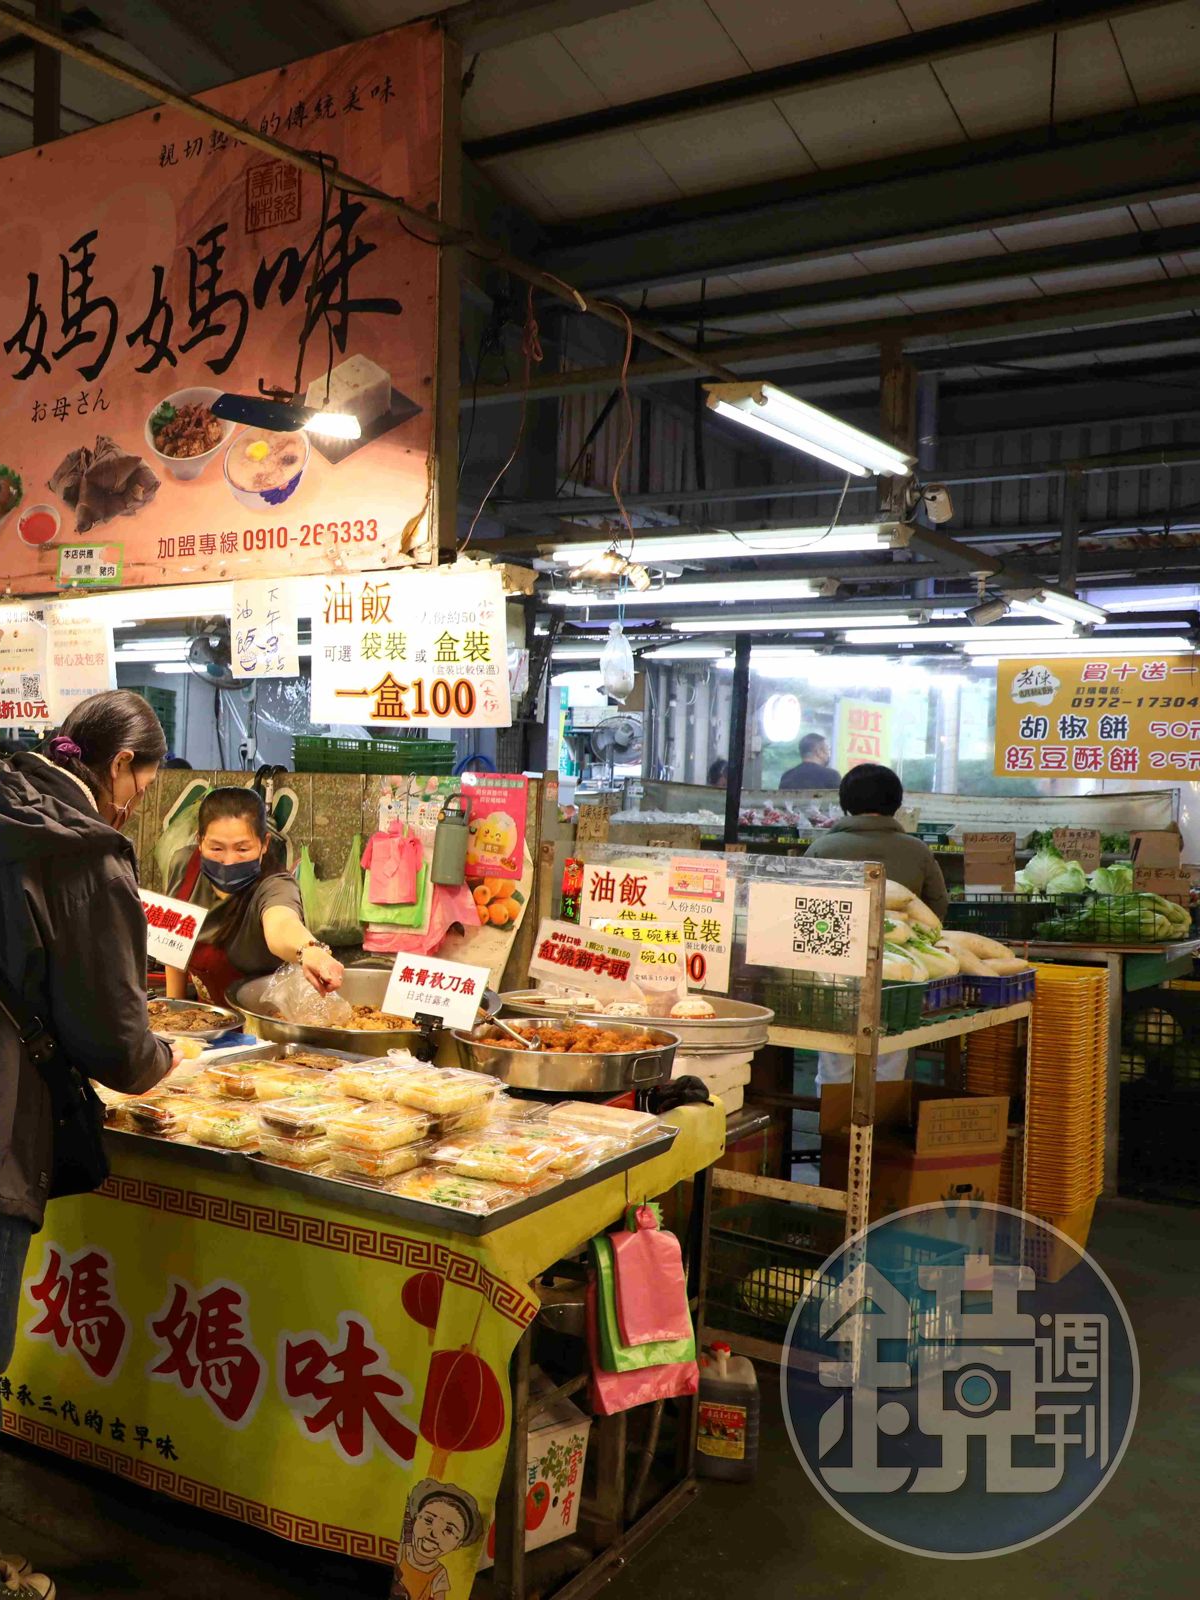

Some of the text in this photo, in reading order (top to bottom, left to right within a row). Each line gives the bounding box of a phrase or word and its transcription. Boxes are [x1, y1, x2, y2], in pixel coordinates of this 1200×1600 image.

[31, 393, 111, 424] お母さん
[156, 531, 239, 559] 加盟專線
[323, 581, 393, 625] 油飯
[324, 630, 492, 664] 可選 袋裝 或 盒裝
[1083, 663, 1197, 682] 買十送一
[335, 672, 477, 719] 一盒100
[1020, 716, 1128, 740] 胡椒餅
[1006, 747, 1138, 772] 紅豆酥餅
[589, 871, 647, 907] 油飯
[142, 901, 197, 940] 燒鯽魚
[399, 965, 477, 996] 無骨秋刀魚
[28, 1248, 419, 1461] 媽媽味
